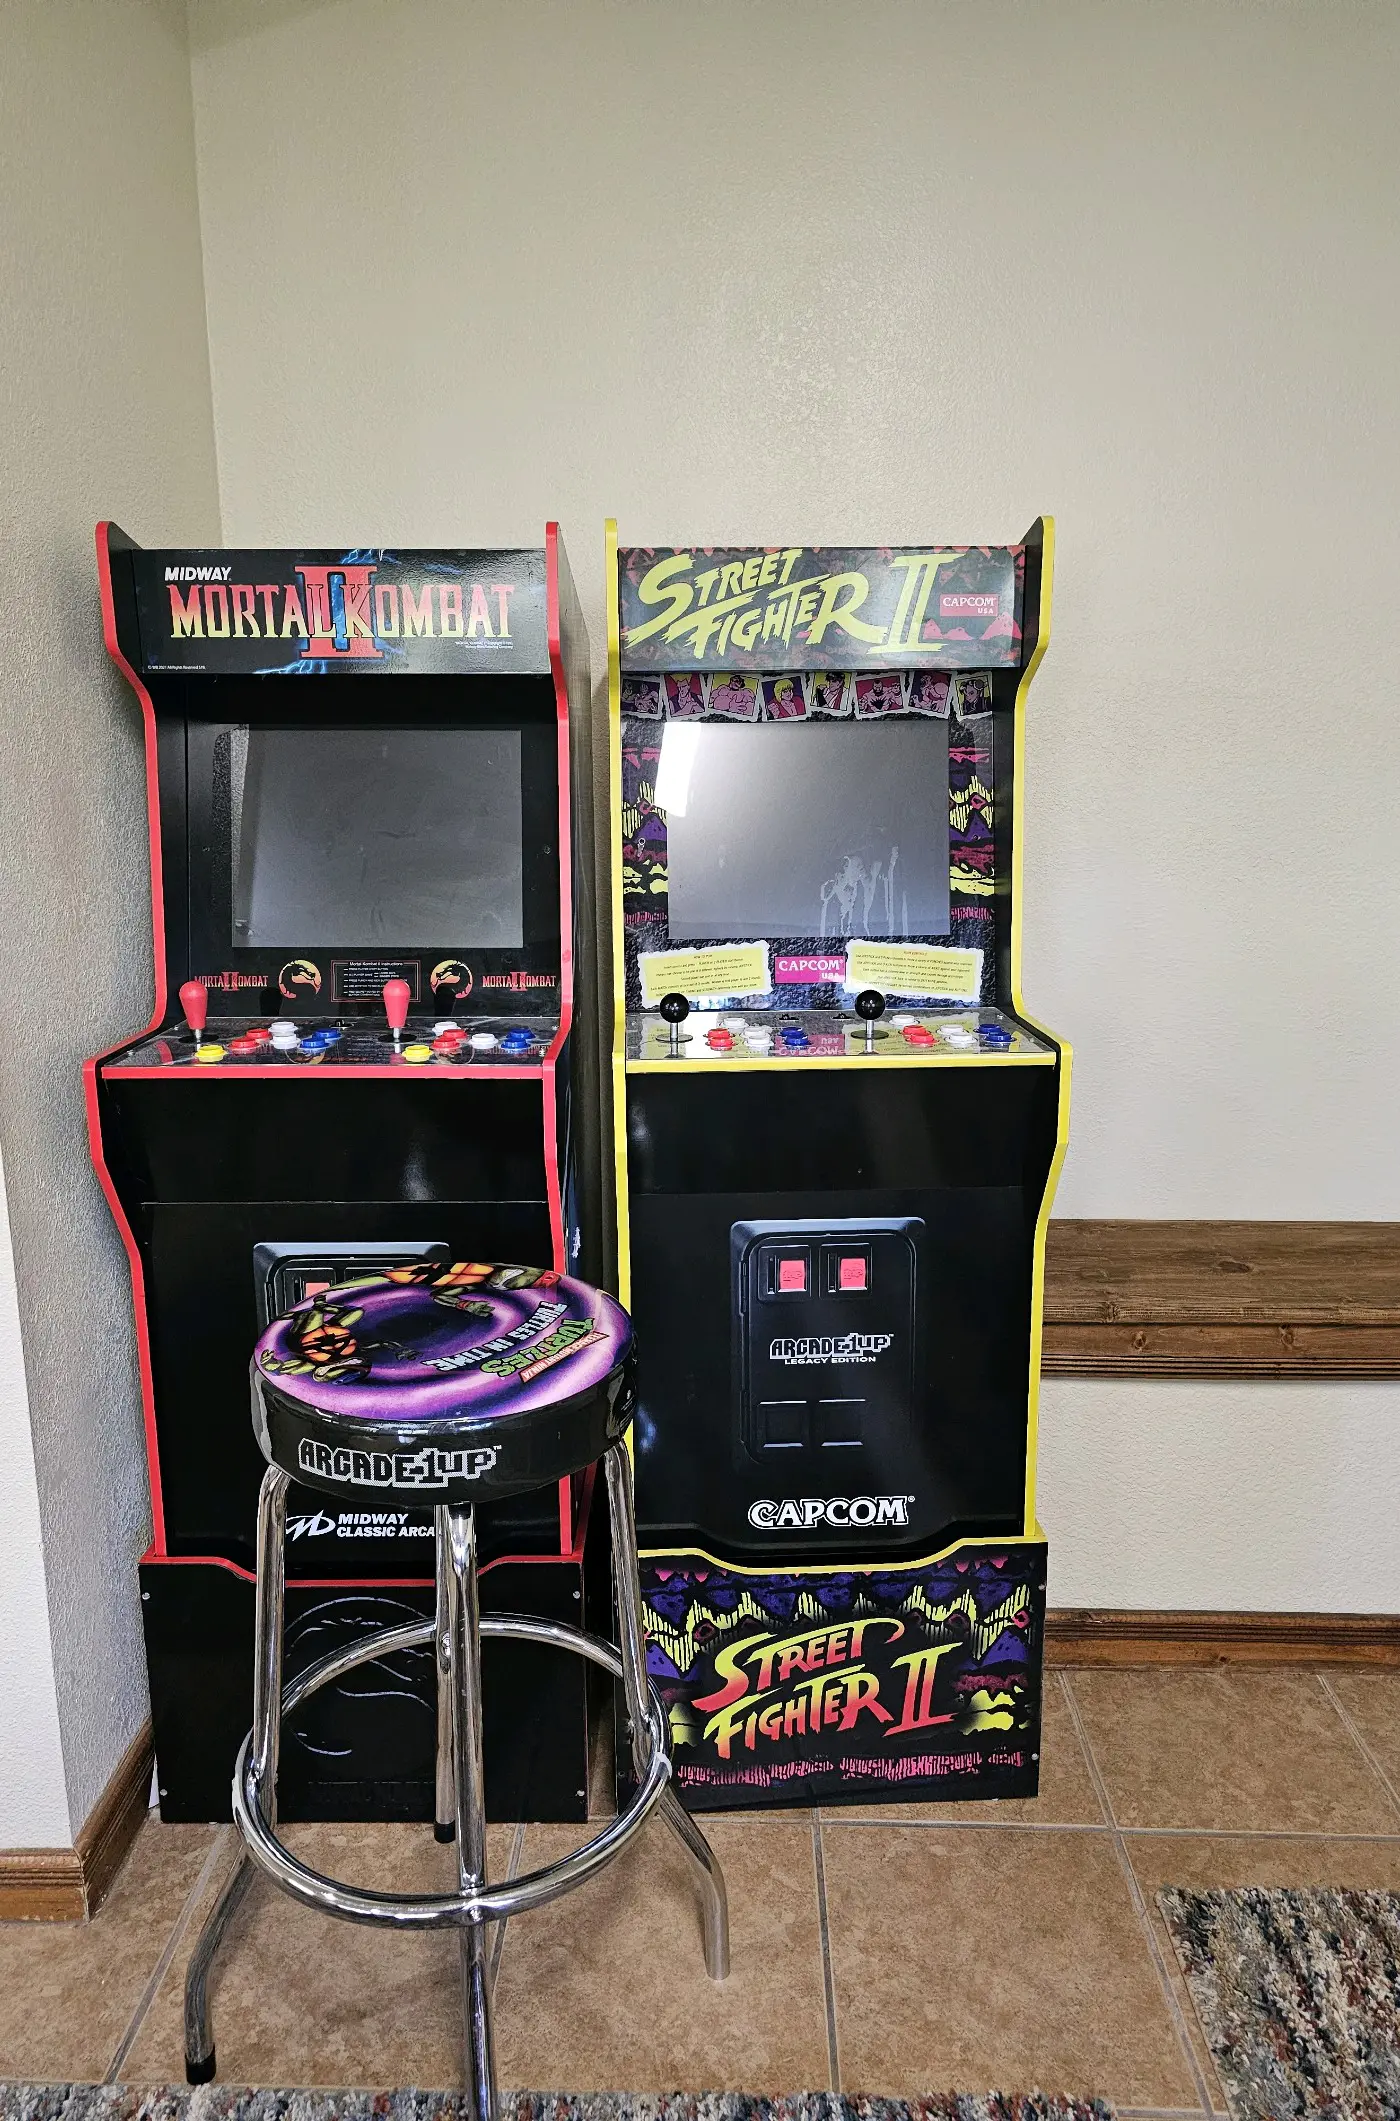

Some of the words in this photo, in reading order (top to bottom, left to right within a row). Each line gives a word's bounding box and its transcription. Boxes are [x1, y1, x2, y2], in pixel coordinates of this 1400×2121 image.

[164, 566, 230, 581] MIDWAY
[621, 548, 803, 652] STREET
[665, 572, 890, 659] FIGHTER
[865, 553, 968, 654] II
[942, 596, 995, 607] CAPCOM
[166, 584, 337, 638] MORTAL
[340, 584, 515, 638] KOMBAT
[778, 959, 840, 972] CAPCOM
[482, 975, 518, 988] MORTAL
[519, 975, 557, 988] KOMBAT
[480, 1318, 594, 1377] TURTLES
[482, 1337, 515, 1352] IN
[421, 1347, 493, 1371] TIME
[784, 1357, 829, 1365] LEGACY
[831, 1356, 877, 1364] EDITION
[338, 1513, 408, 1525] MIDWAY
[748, 1496, 909, 1529] CAPCOM
[336, 1526, 396, 1538] CLASSIC
[398, 1526, 436, 1537] ARCA
[692, 1617, 905, 1712] STREET
[703, 1663, 893, 1760] FIGHTER
[881, 1642, 962, 1737] II
